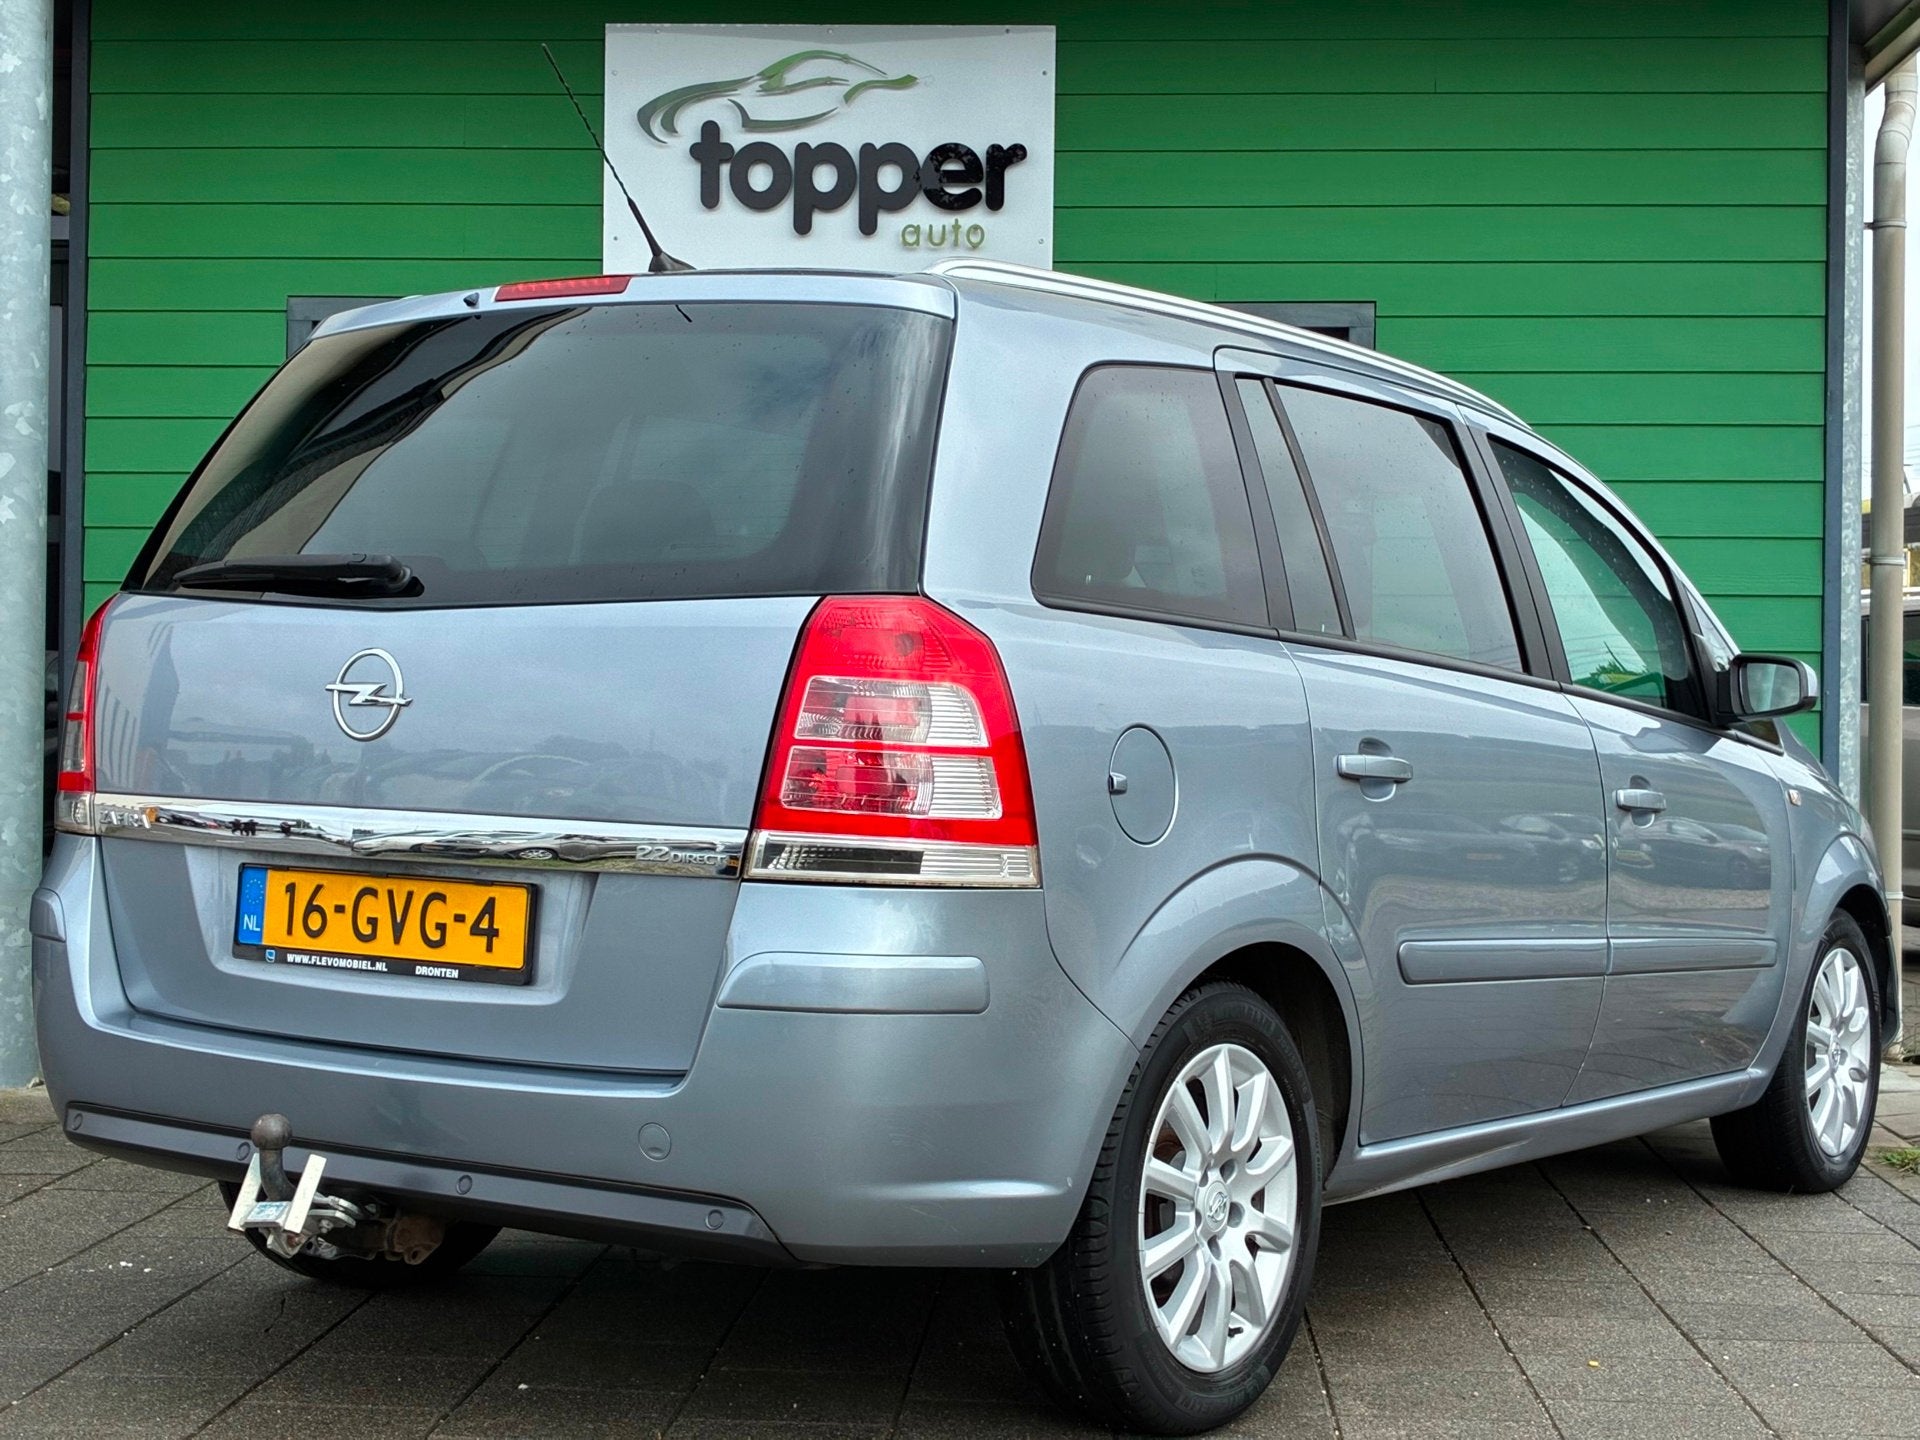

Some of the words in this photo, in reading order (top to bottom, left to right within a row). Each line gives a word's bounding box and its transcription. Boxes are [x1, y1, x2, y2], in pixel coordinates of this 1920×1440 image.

[689, 120, 1028, 236] topper
[901, 218, 985, 248] auto
[243, 914, 261, 932] NL
[284, 881, 500, 953] 16-GVG-4
[286, 953, 388, 972] WWW.FLEVOMOBIEL.NL
[415, 965, 459, 979] DRONTEN
